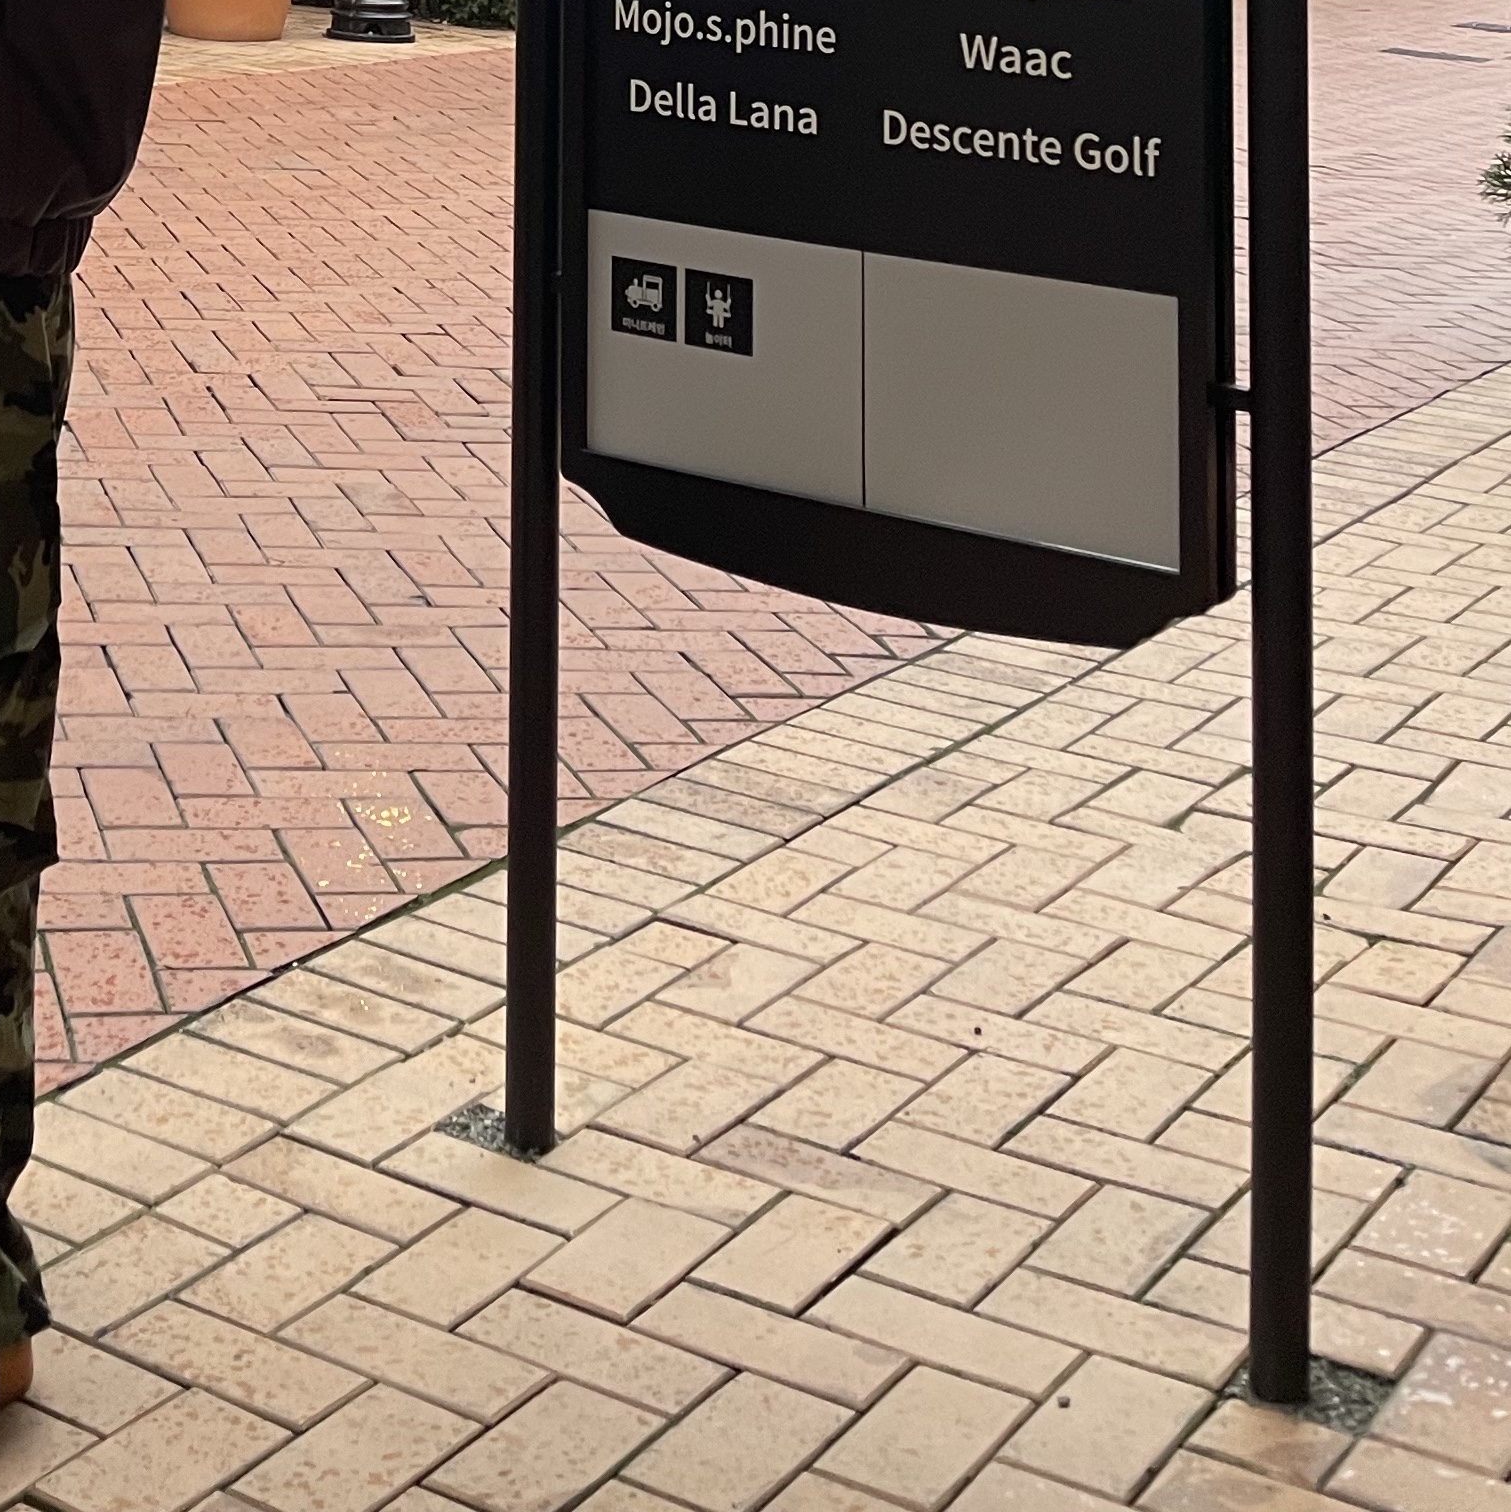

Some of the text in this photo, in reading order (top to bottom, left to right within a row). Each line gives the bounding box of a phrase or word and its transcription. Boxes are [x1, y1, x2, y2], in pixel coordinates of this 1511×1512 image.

[959, 32, 1072, 79] Waac
[630, 78, 818, 135] Della Lana
[883, 109, 1162, 177] Descente Golf
